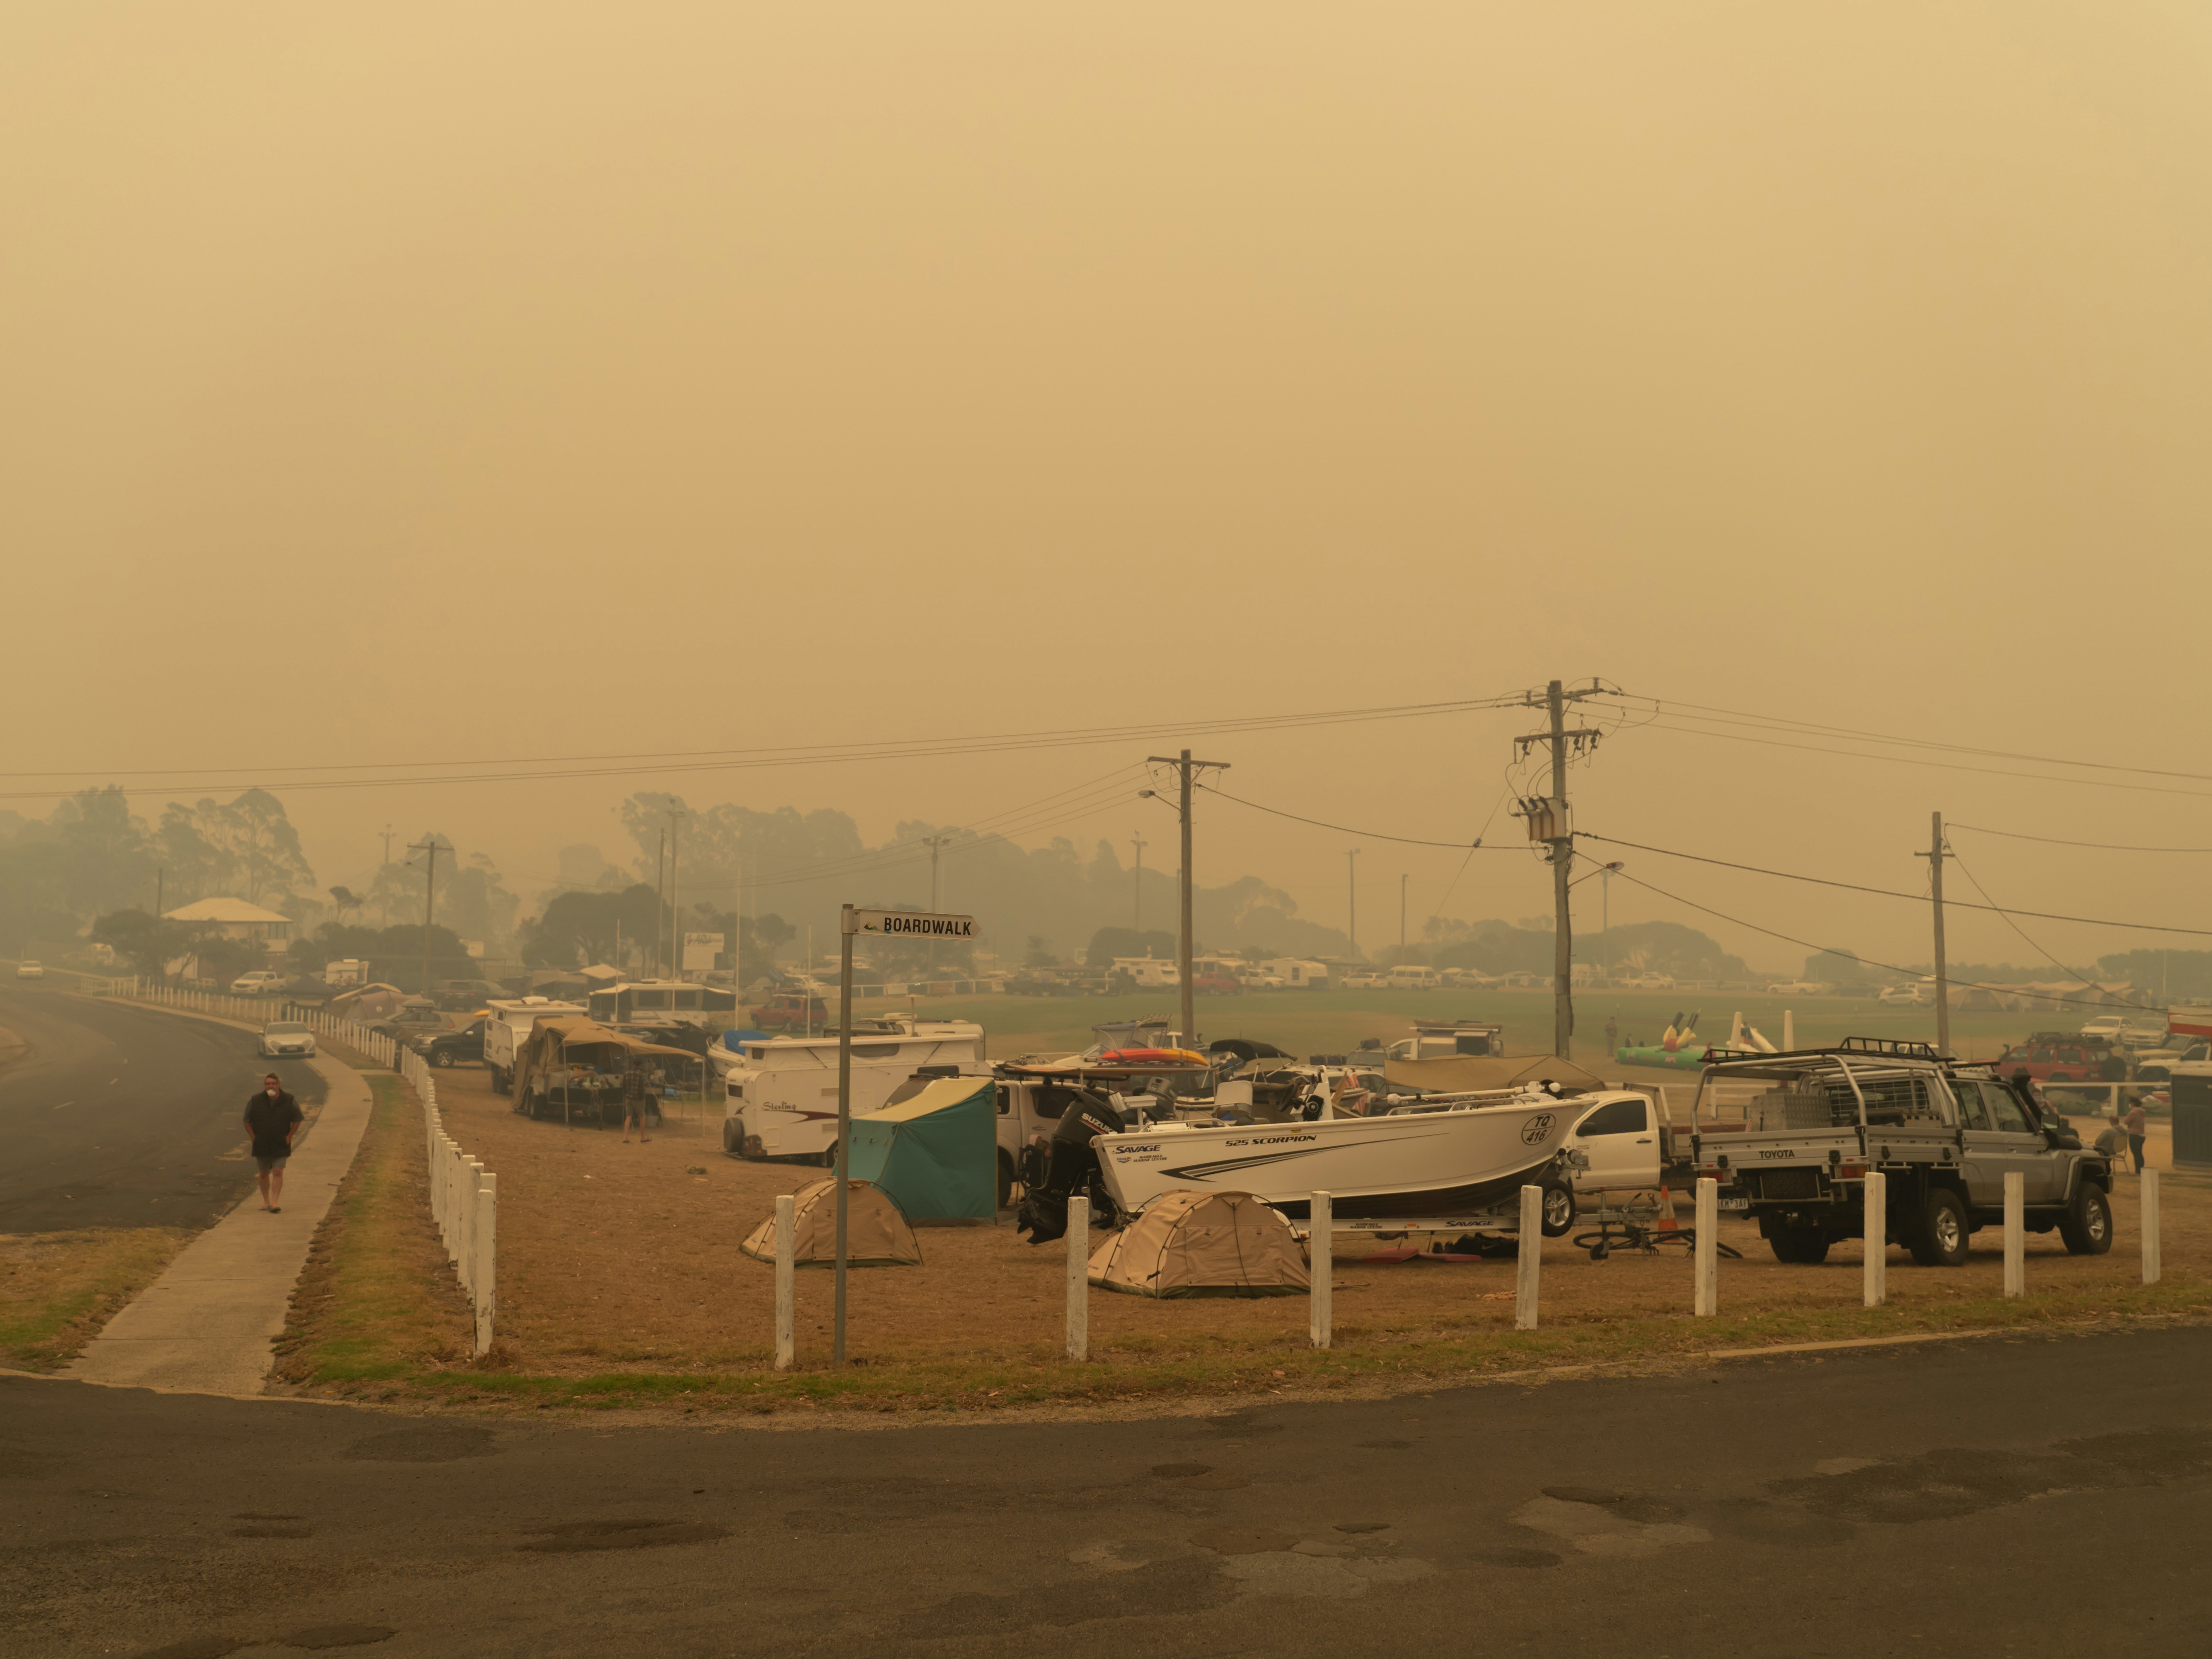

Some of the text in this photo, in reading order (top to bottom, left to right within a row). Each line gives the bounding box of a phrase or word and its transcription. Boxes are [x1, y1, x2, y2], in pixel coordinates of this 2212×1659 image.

[884, 917, 971, 936] BOARDWALK
[761, 1101, 796, 1111] Sterling
[1082, 1113, 1115, 1132] SUZUK
[1535, 1115, 1550, 1127] TQ
[1251, 1135, 1316, 1145] SCORPION
[1526, 1129, 1547, 1143] 416
[1759, 1150, 1795, 1159] TOYOTA
